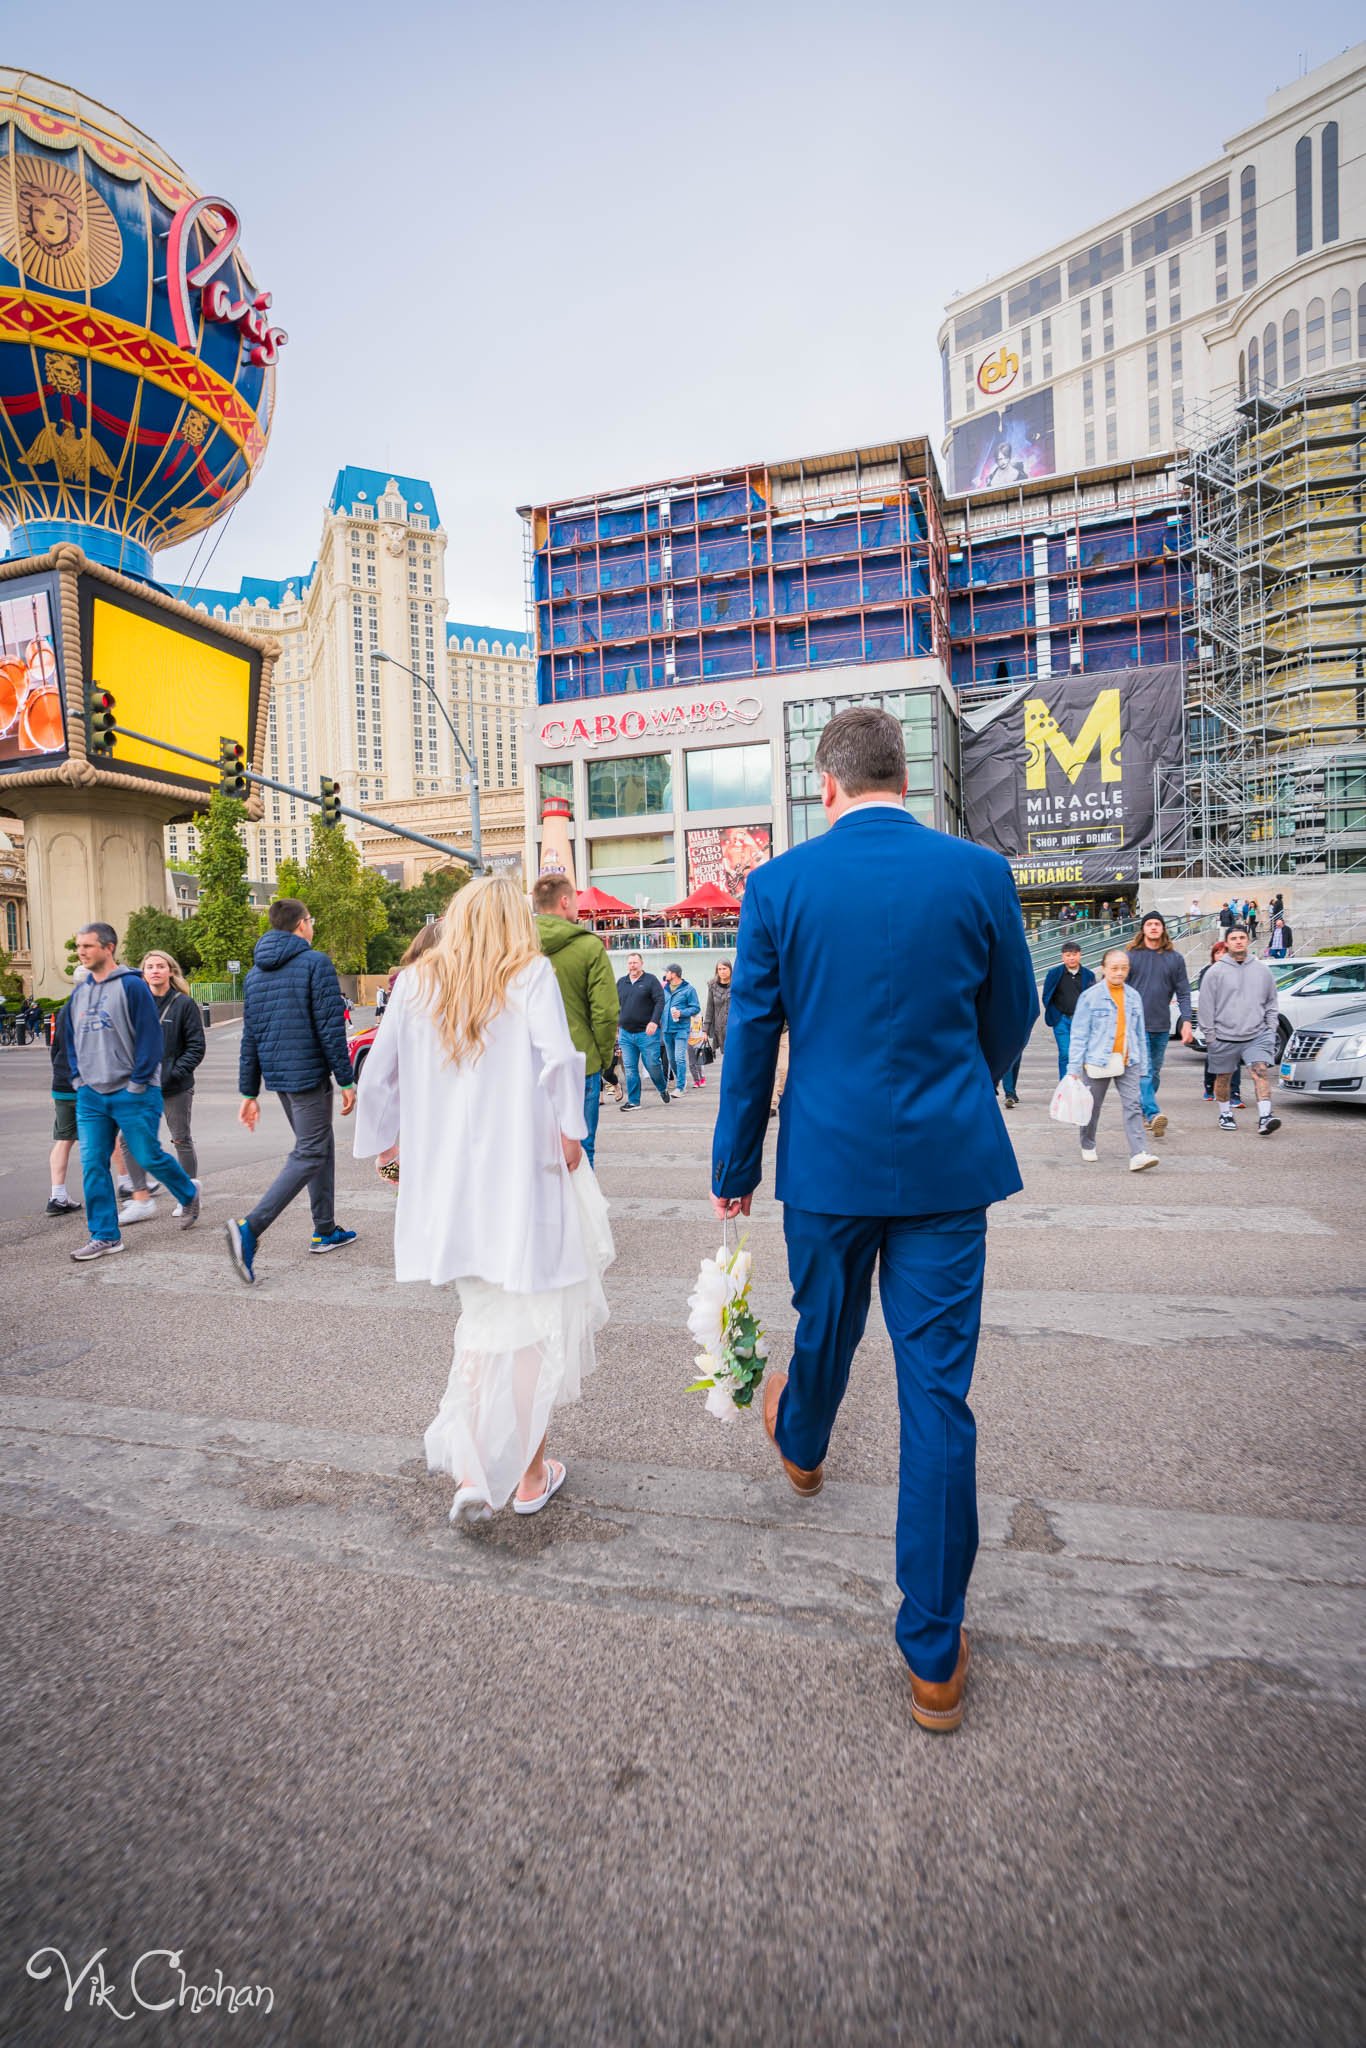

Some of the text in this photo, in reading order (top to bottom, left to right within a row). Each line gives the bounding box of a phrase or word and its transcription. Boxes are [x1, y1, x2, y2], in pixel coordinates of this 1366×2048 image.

[166, 195, 289, 367] Paris
[982, 346, 1019, 392] ph
[540, 700, 740, 749] CABO WABO
[1027, 790, 1122, 812] MIRACLE
[1028, 808, 1123, 826] MILE SHOPS
[688, 830, 720, 842] KILLER
[1036, 832, 1114, 848] SHOP. DINE. DRINK.
[692, 845, 721, 857] CABO
[692, 853, 722, 864] WABO
[1012, 866, 1083, 885] ENTRANCE
